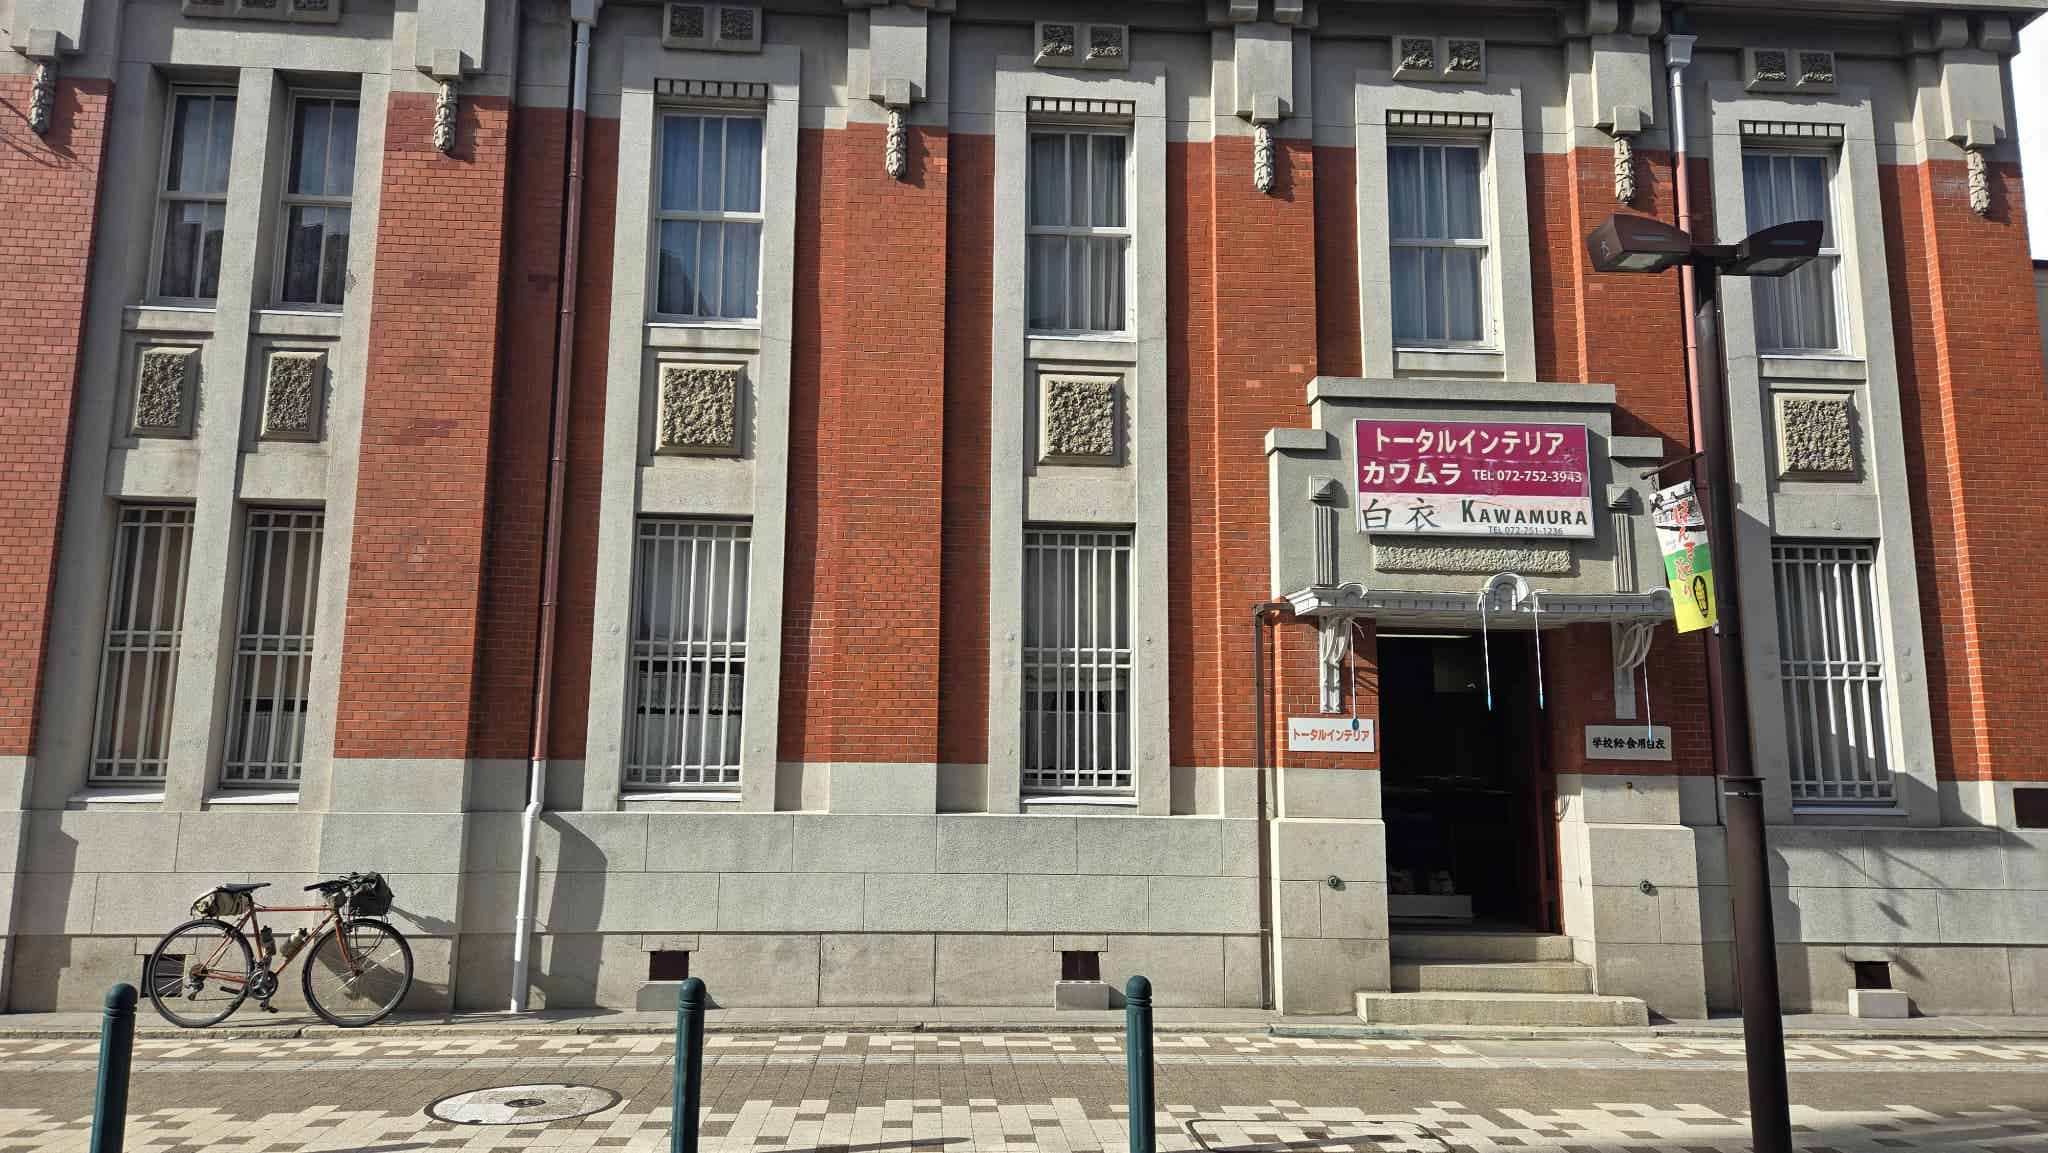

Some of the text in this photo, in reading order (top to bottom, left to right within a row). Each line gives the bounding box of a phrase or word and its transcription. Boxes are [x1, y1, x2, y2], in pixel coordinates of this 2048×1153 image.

[1376, 427, 1564, 455] トータルインテリア
[1363, 461, 1462, 485] カワムラ
[1472, 469, 1582, 482] TEL 072-752-3943
[1362, 497, 1441, 531] 白衣
[1488, 526, 1502, 535] TEL
[1293, 728, 1370, 742] トータルインテリア
